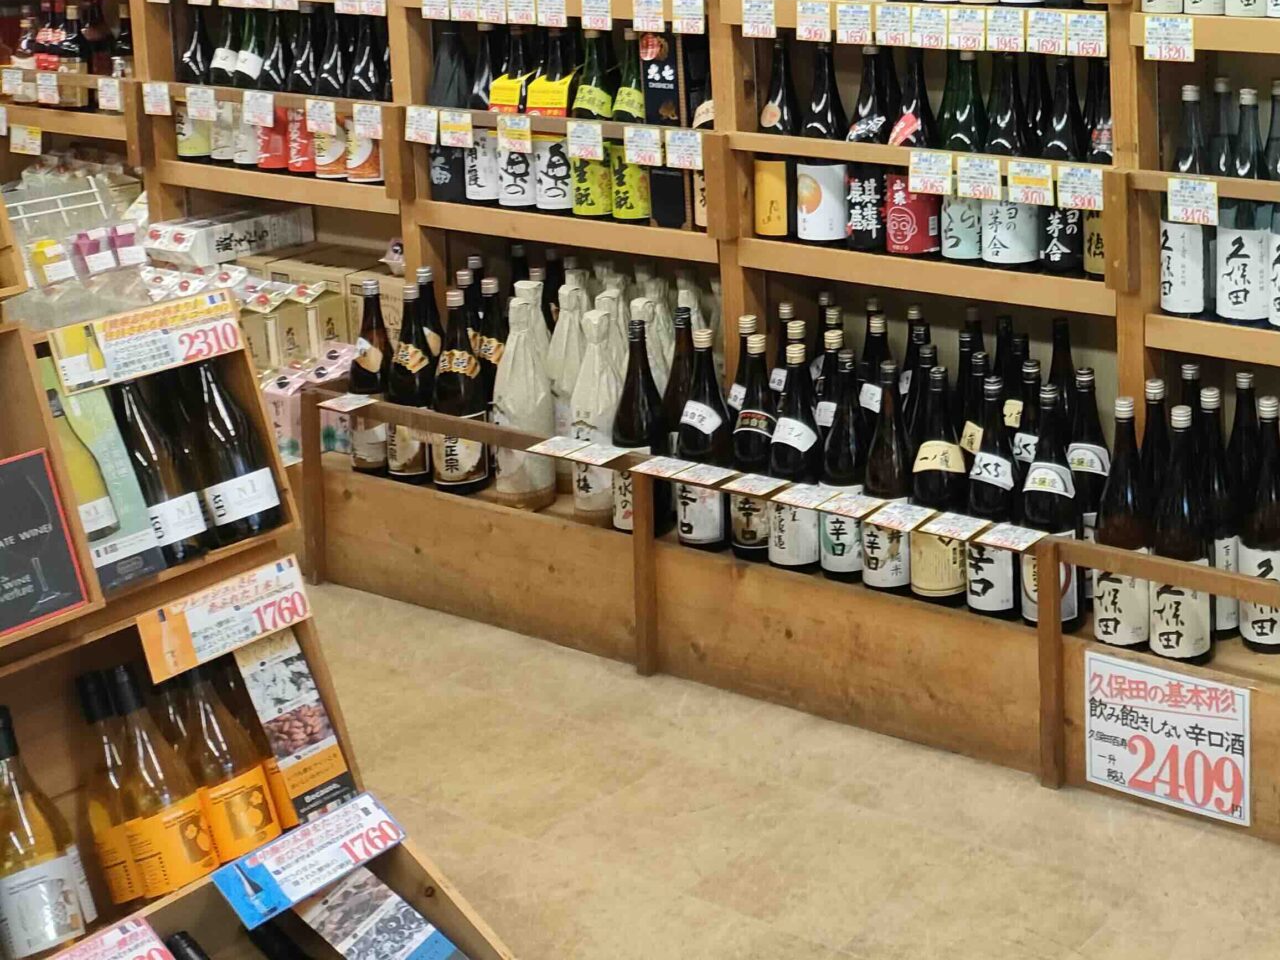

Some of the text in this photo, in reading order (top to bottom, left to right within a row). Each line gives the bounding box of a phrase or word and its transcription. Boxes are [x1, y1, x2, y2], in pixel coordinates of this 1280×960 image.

[1158, 45, 1185, 61] 1320
[1181, 208, 1210, 224] 3476
[1222, 235, 1252, 307] 久保田
[177, 322, 239, 363] 2310
[829, 518, 848, 557] 辛口
[866, 531, 881, 571] 辛口
[253, 591, 307, 634] 1760
[1089, 671, 1237, 714] 久保田の基本形!
[1088, 696, 1245, 758] 飲み飽きしない辛口酒
[1128, 734, 1244, 816] 2409
[339, 820, 400, 865] 1760
